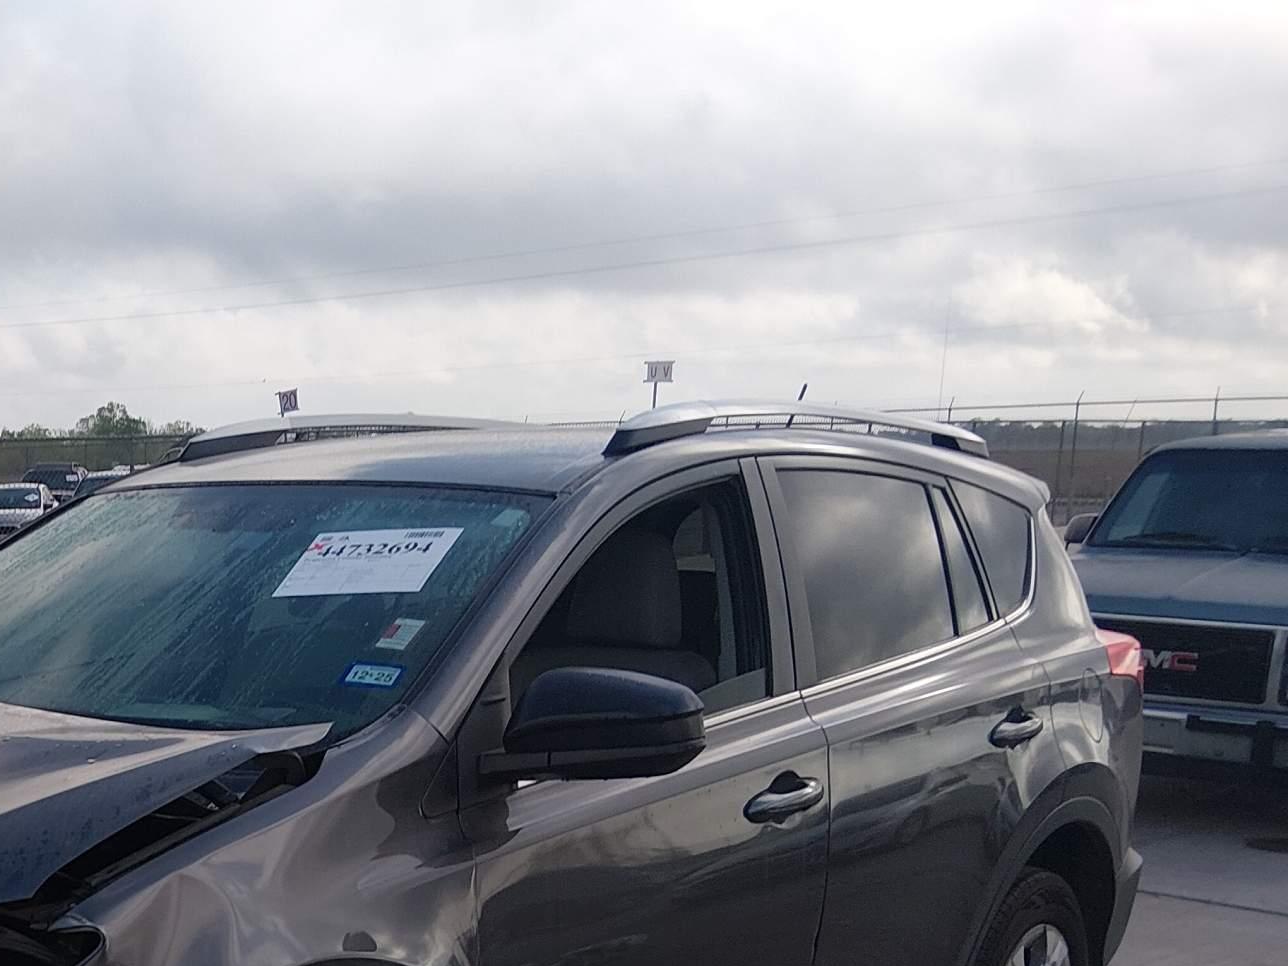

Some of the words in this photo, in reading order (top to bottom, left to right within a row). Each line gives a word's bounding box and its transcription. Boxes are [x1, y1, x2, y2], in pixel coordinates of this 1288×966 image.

[650, 365, 657, 378] U
[282, 391, 297, 410] 20
[317, 541, 433, 558] 44732694
[1142, 649, 1199, 672] MC
